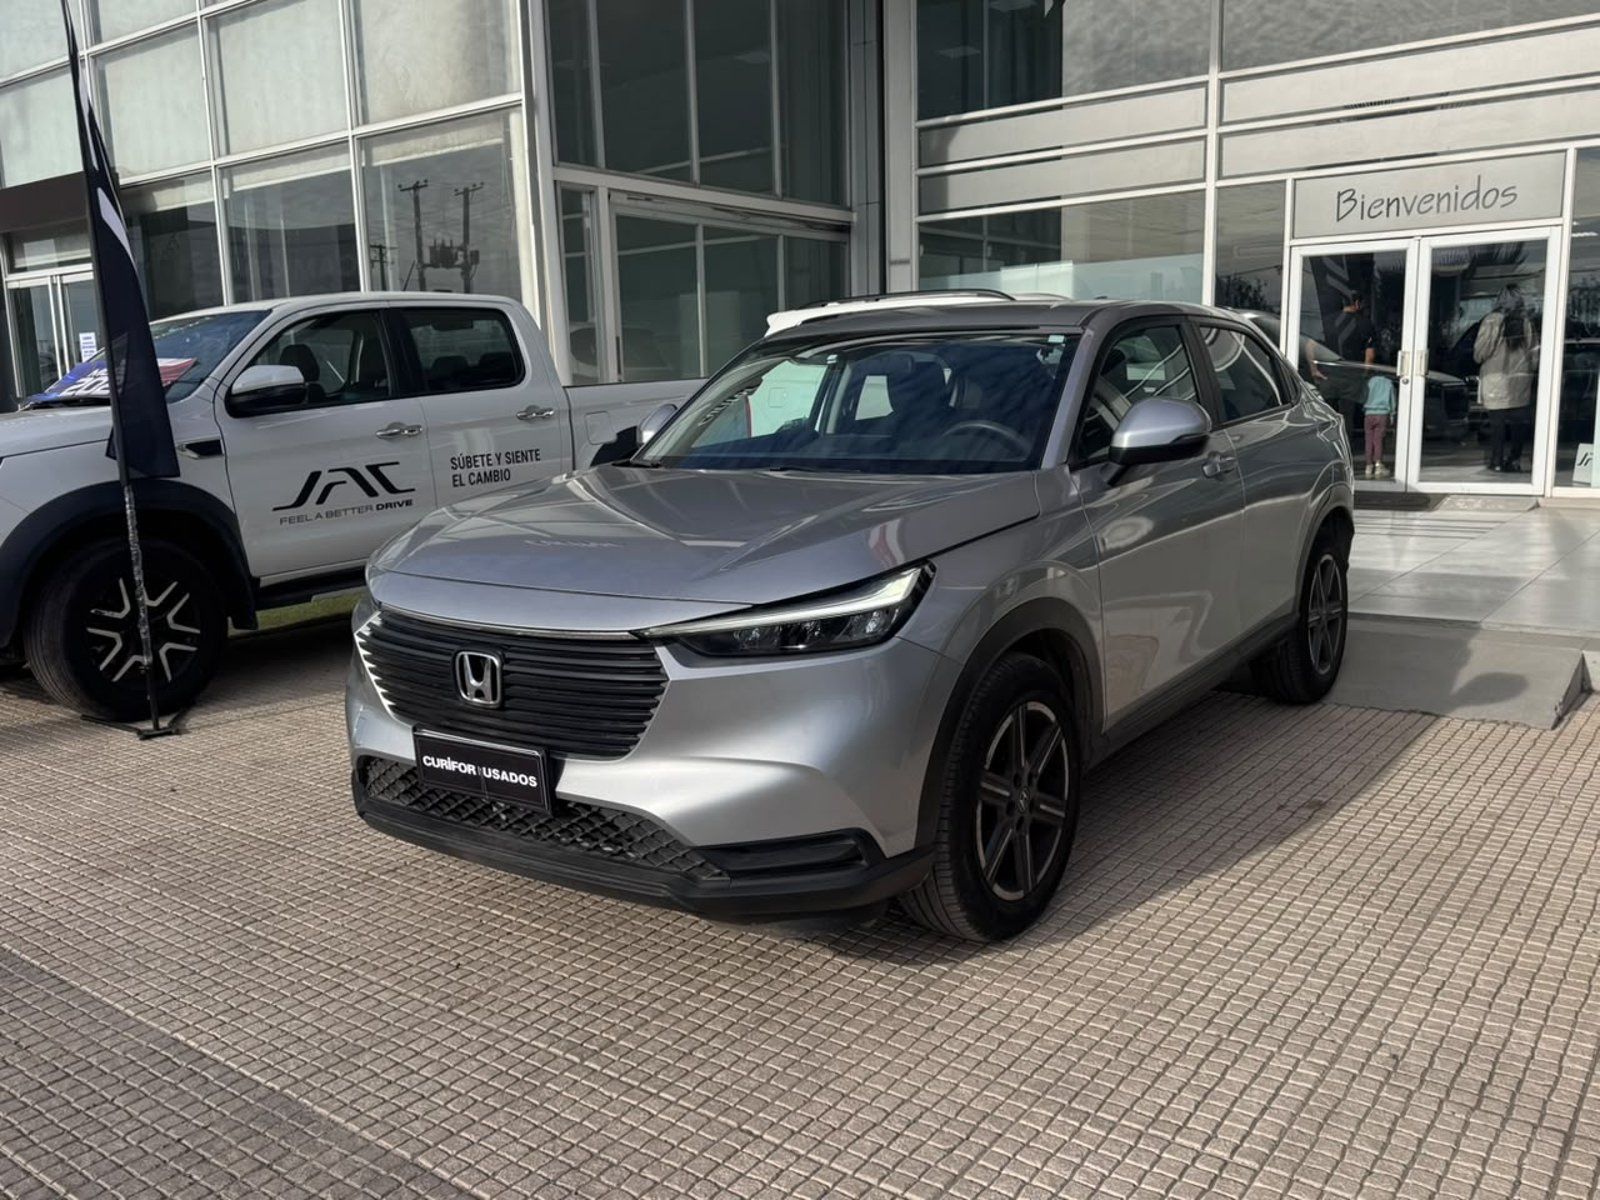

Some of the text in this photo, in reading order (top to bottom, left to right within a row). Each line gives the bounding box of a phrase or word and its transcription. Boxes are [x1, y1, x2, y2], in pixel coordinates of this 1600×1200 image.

[1336, 175, 1517, 222] Bienvenidos
[450, 448, 541, 470] SÚBETE Y SIENTE
[272, 461, 416, 511] JAC
[452, 468, 511, 487] EL CAMBIO
[279, 499, 413, 525] FEEL A BETTER DRIVE
[482, 766, 538, 788] USADOS
